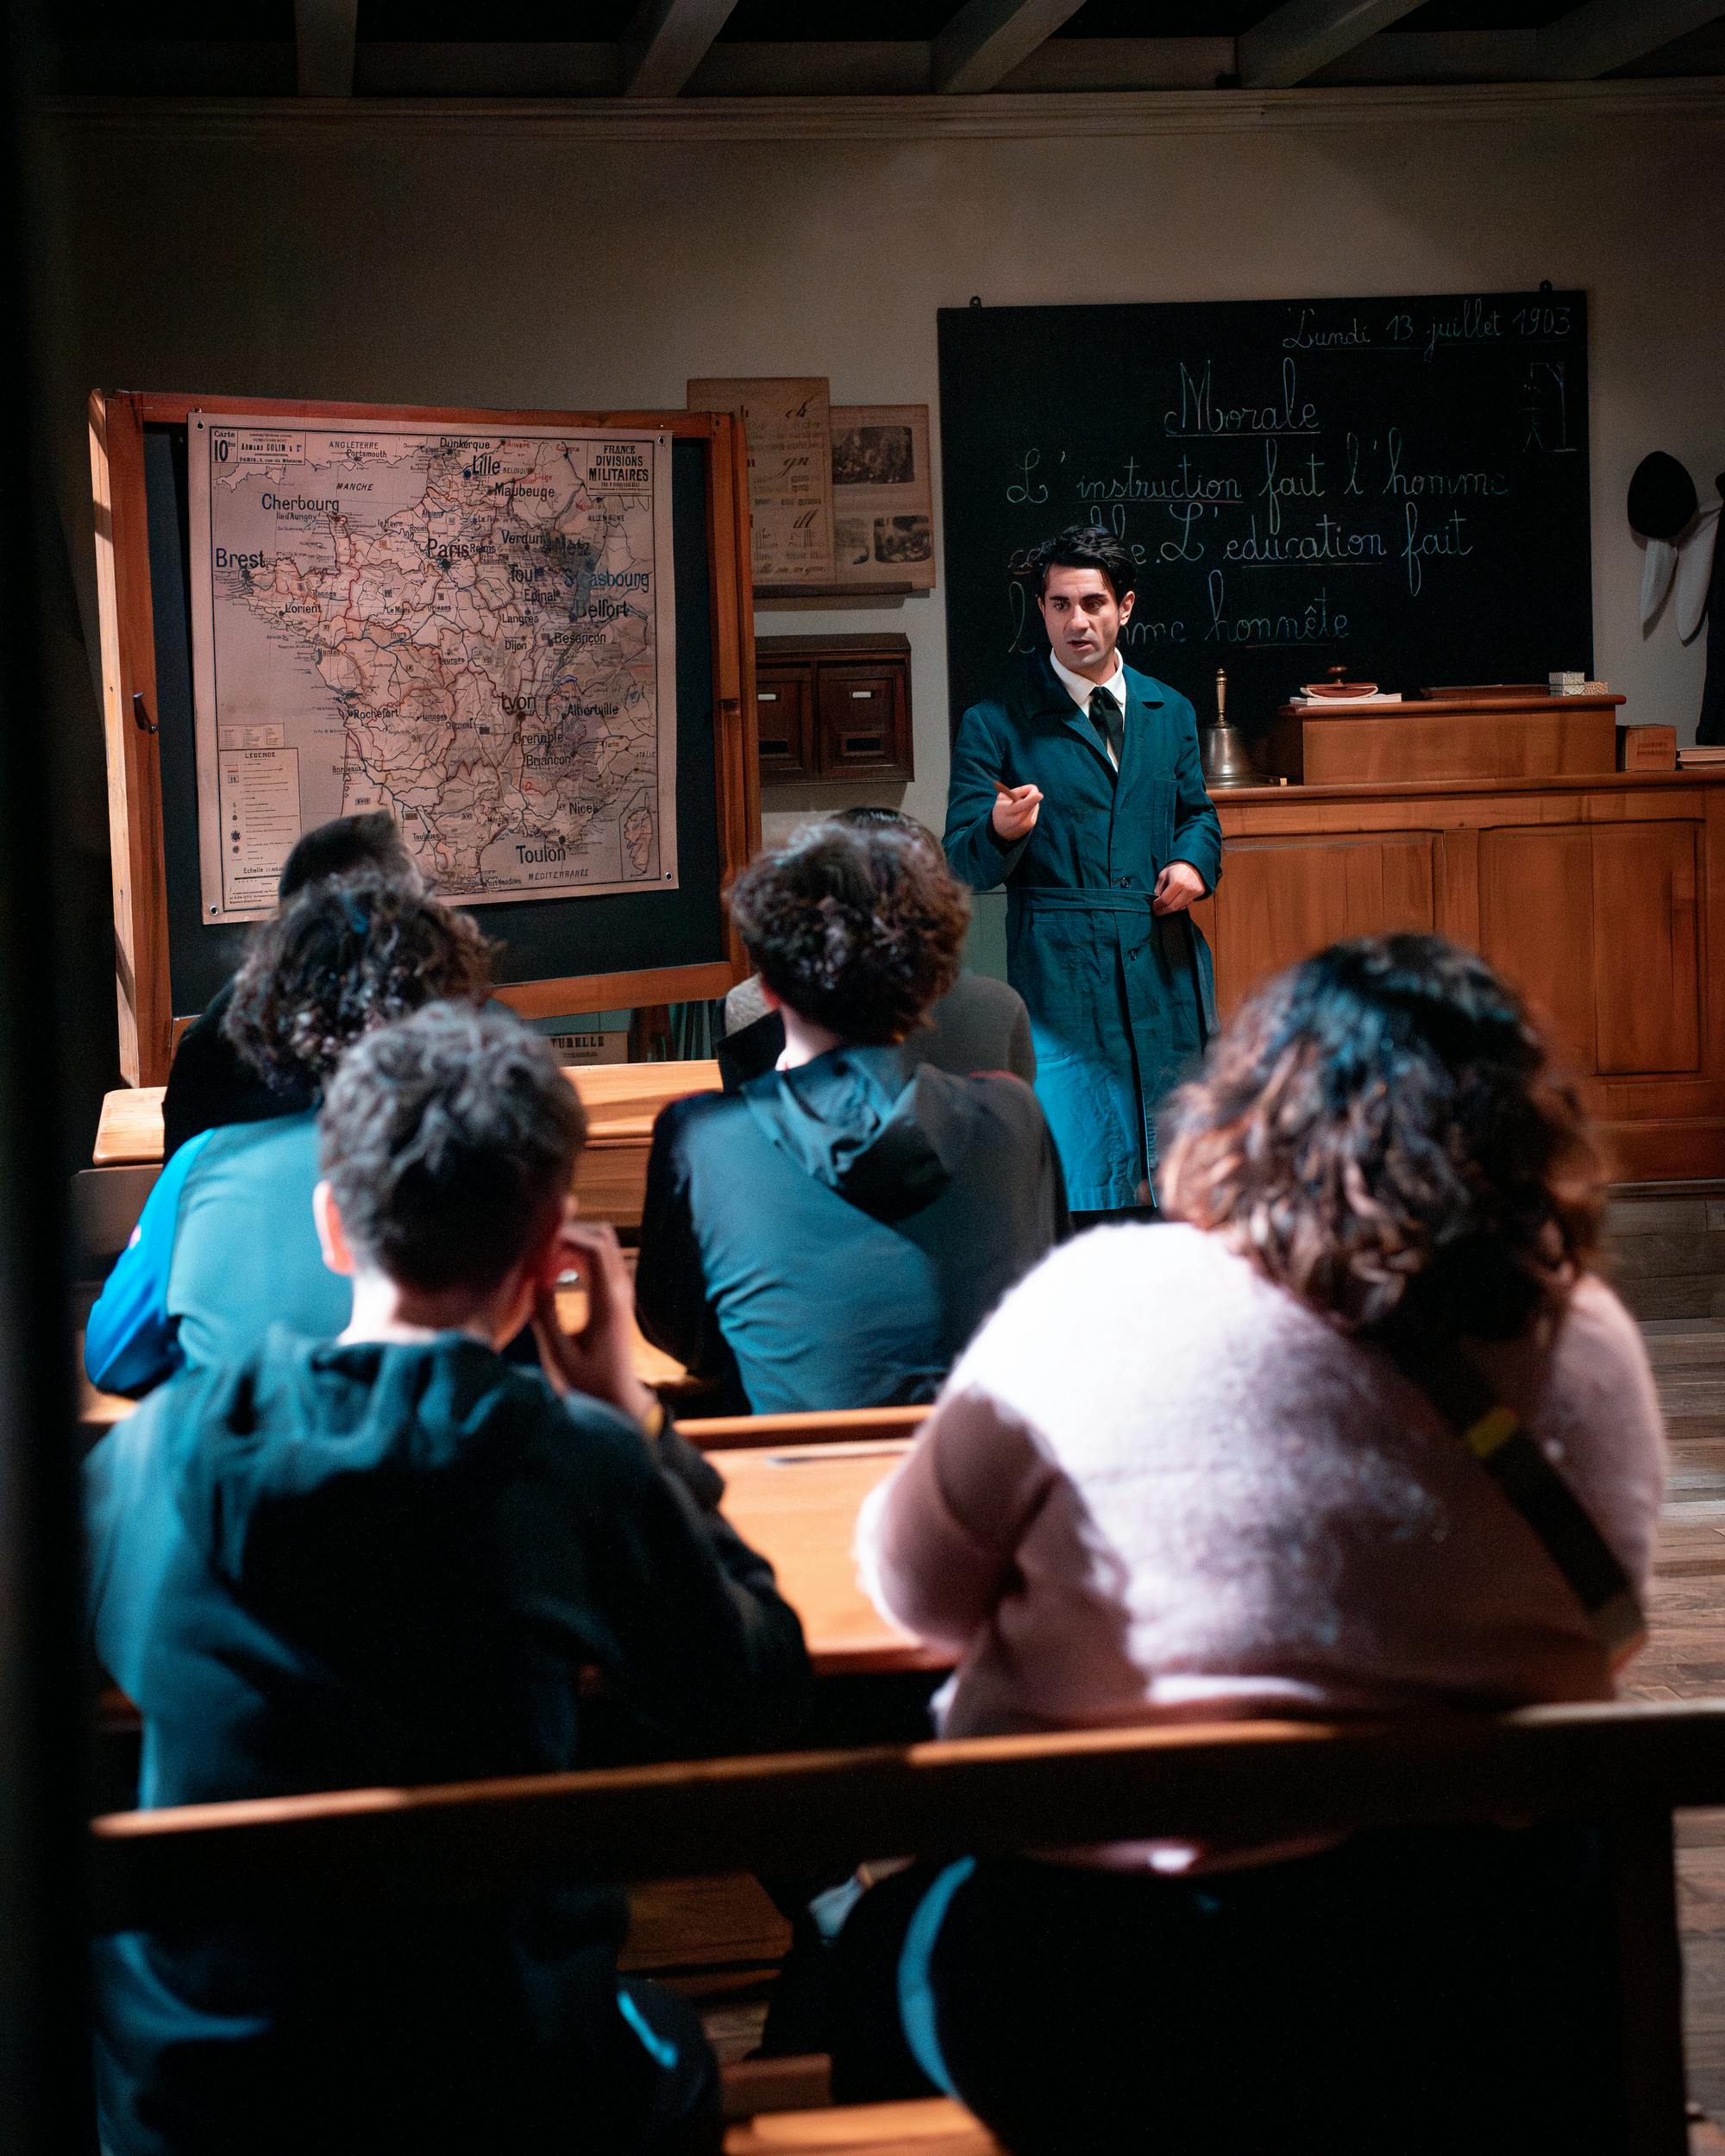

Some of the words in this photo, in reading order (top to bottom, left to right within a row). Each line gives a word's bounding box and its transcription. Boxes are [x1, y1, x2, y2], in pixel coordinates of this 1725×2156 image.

[1283, 307, 1371, 348] Lundi
[1385, 314, 1414, 341] 13
[1425, 298, 1502, 362] juillet
[1512, 305, 1571, 335] 1903
[1164, 357, 1320, 433] Morale
[440, 437, 490, 452] Dunkerque
[604, 445, 635, 454] FRANCE
[347, 449, 387, 458] Portsmouth
[596, 455, 643, 467] DIVISIONS
[473, 455, 500, 475] Lille
[588, 468, 649, 481] MILITAIRES
[337, 483, 373, 492] MANCHE
[494, 483, 555, 502] Maubeuge
[1258, 438, 1326, 535] fait
[262, 493, 339, 512] Cherbourg
[502, 529, 544, 545] Verdun
[427, 538, 470, 559] Paris
[1401, 502, 1473, 596] fait
[216, 548, 266, 568] Brest
[285, 603, 322, 614] Lorient
[1204, 569, 1352, 643] honnête
[502, 613, 539, 628] Langres
[354, 708, 399, 720] Rochefort
[568, 803, 593, 815] Nice
[516, 844, 566, 864] Toulon
[550, 1036, 605, 1048] TURELLE
